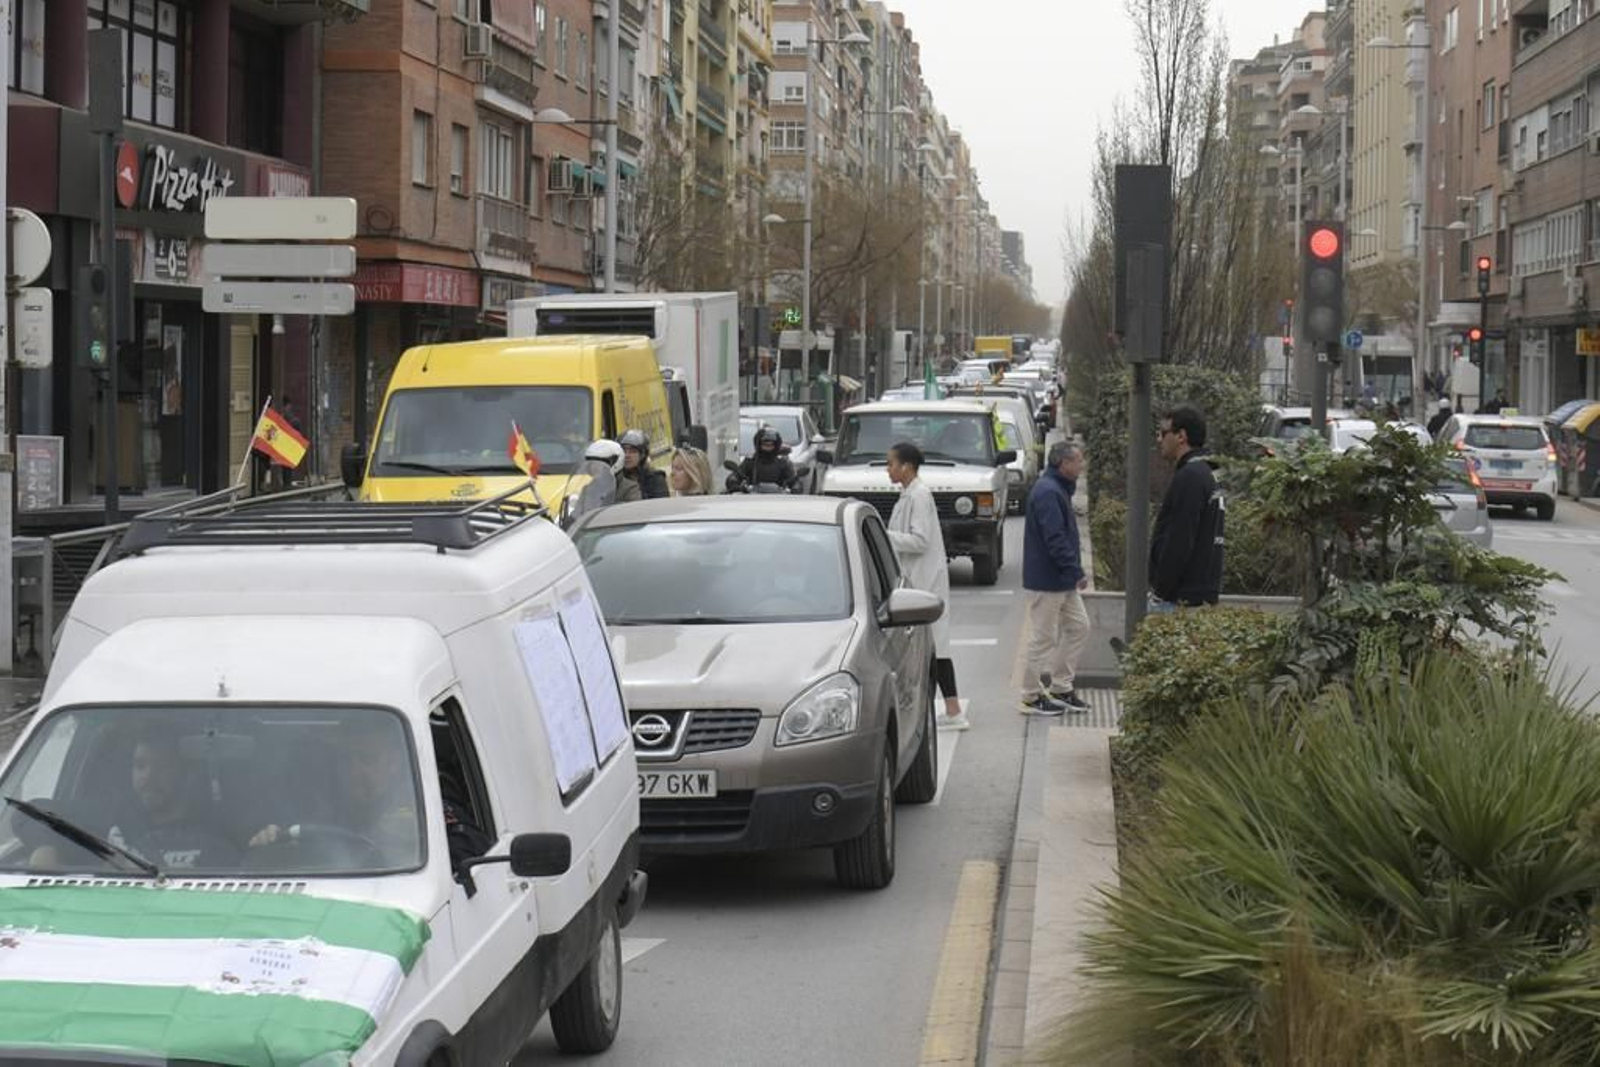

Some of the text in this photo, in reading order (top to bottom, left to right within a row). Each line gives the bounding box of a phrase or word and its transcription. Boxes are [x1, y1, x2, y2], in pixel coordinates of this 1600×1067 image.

[148, 145, 199, 211] Pizza
[200, 157, 236, 212] Hut
[667, 774, 710, 794] GKW
